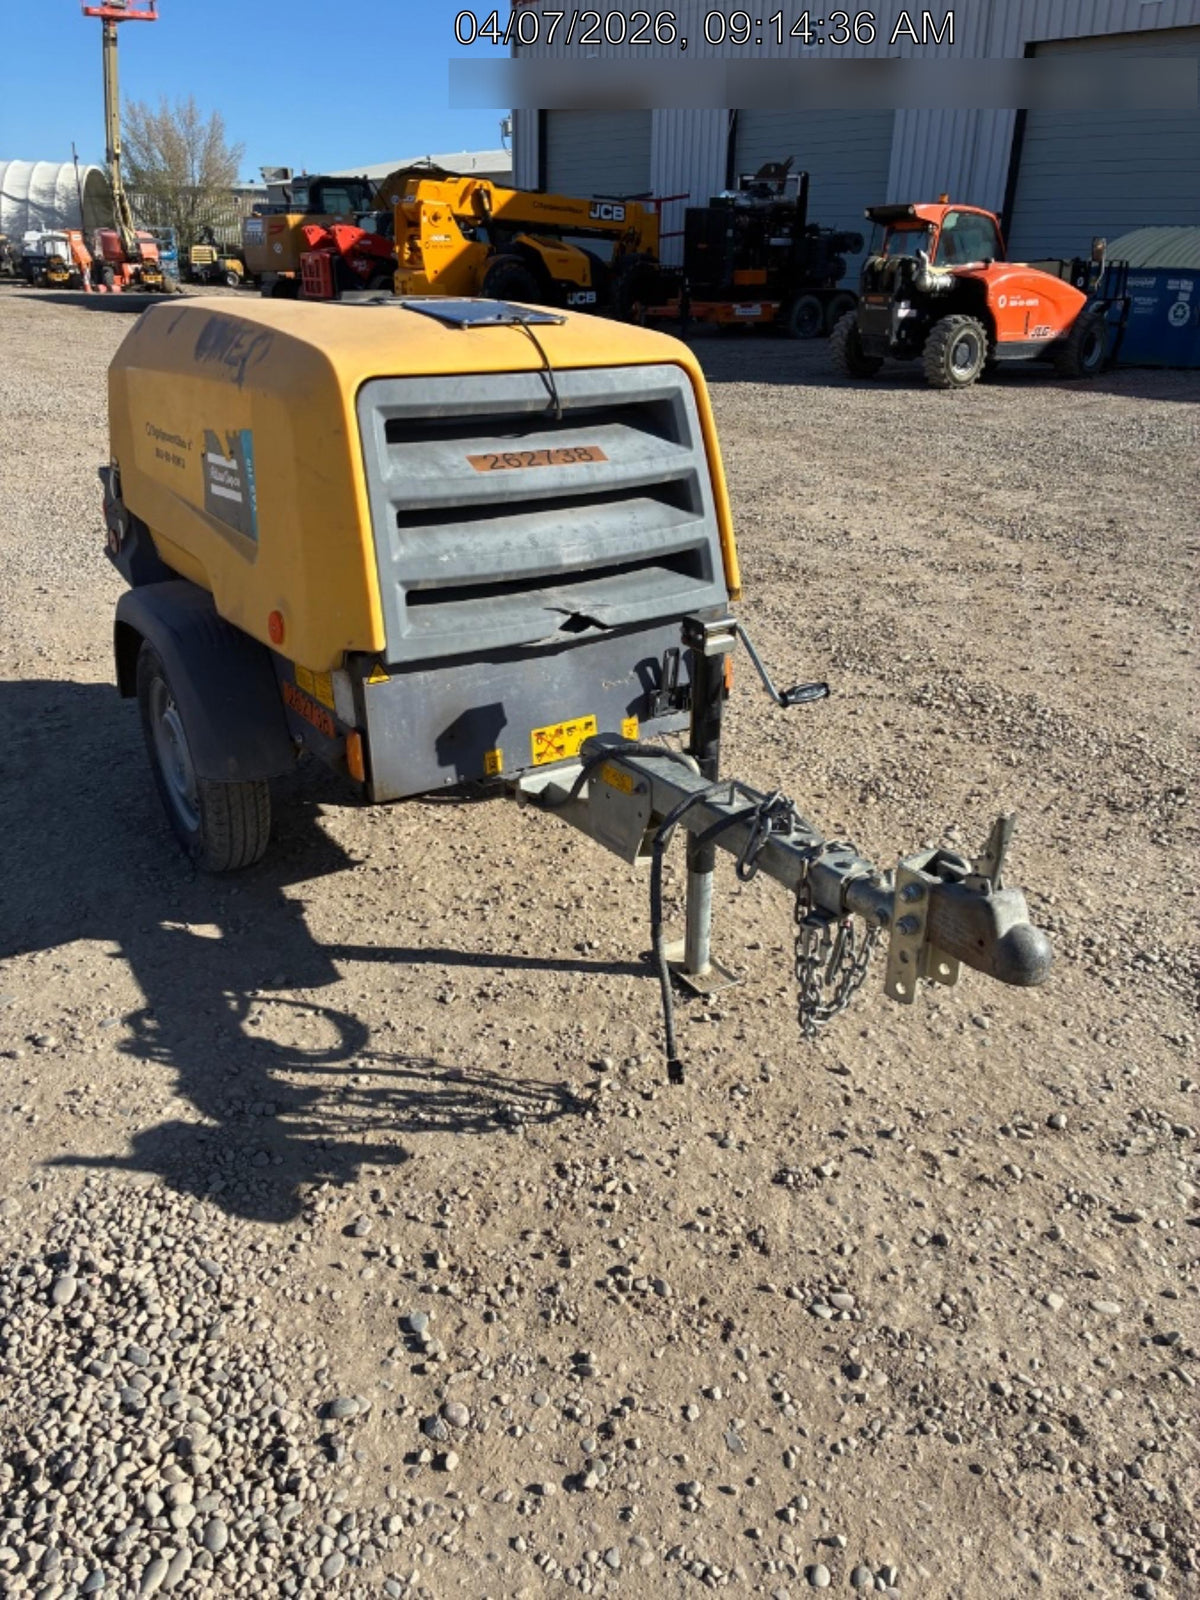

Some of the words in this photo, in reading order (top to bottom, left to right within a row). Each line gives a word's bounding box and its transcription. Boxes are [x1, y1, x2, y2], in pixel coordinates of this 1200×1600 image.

[591, 204, 625, 220] JCB
[567, 291, 597, 304] JCB
[483, 448, 593, 470] 262738
